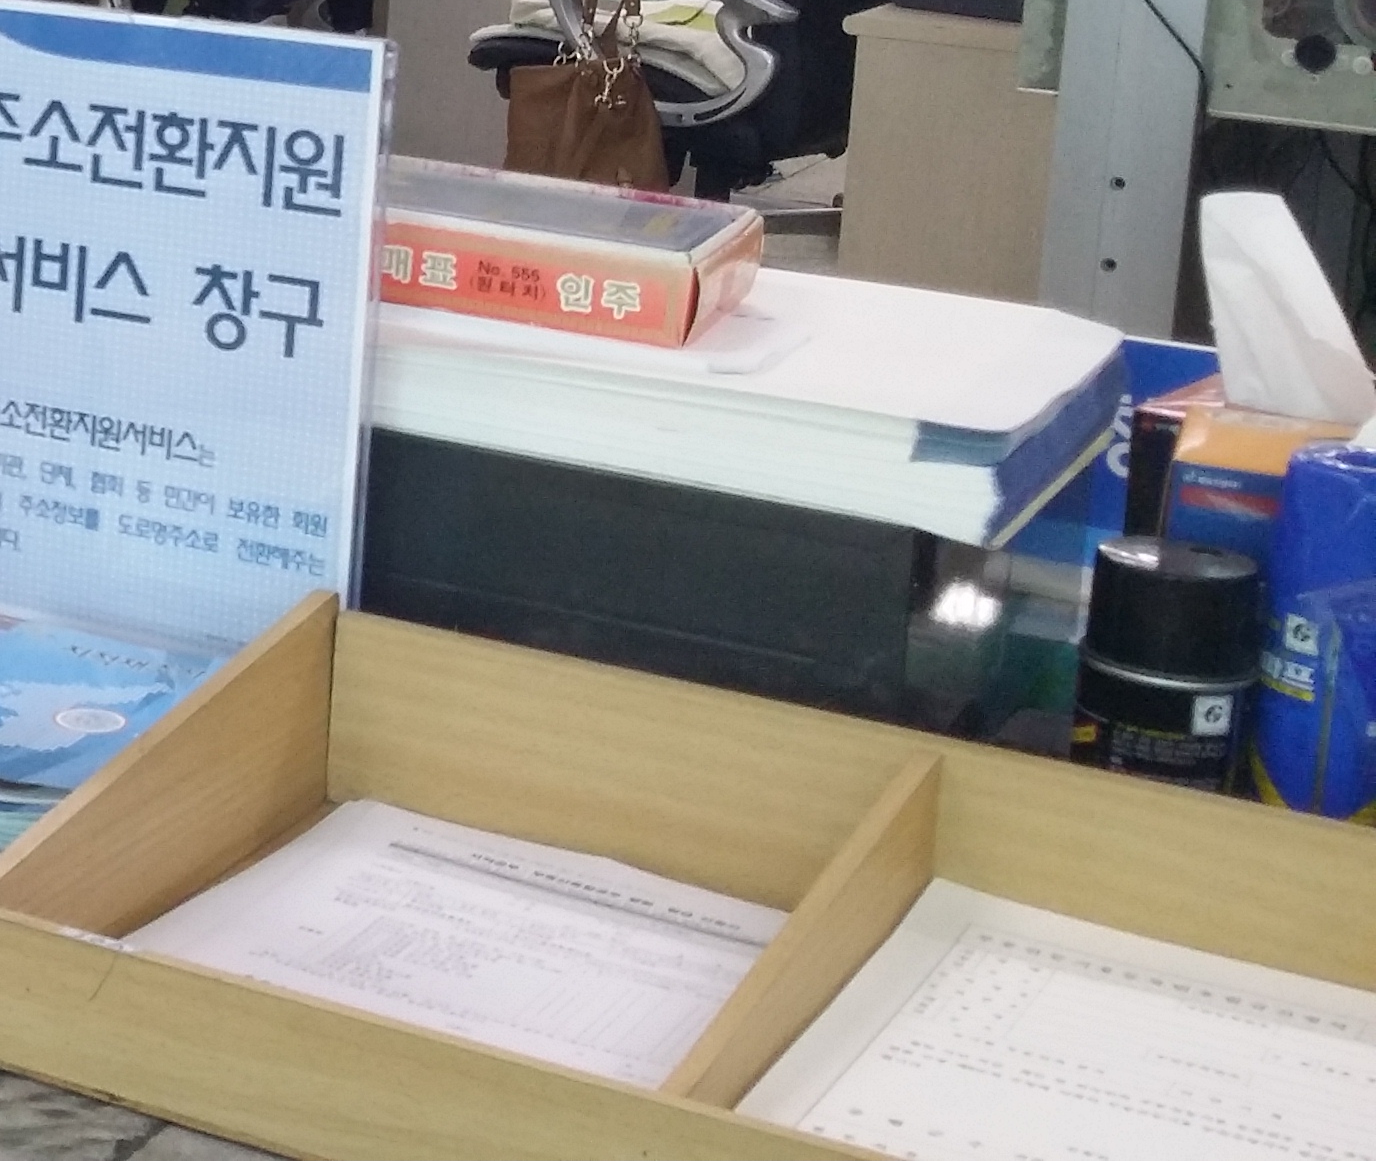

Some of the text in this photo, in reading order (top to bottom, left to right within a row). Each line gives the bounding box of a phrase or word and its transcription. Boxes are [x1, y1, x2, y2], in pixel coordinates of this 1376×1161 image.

[191, 263, 325, 359] 창구
[556, 272, 642, 320] 인주
[118, 513, 219, 554] 도로명주소로
[226, 497, 281, 529] 보유한
[292, 510, 328, 538] 회원
